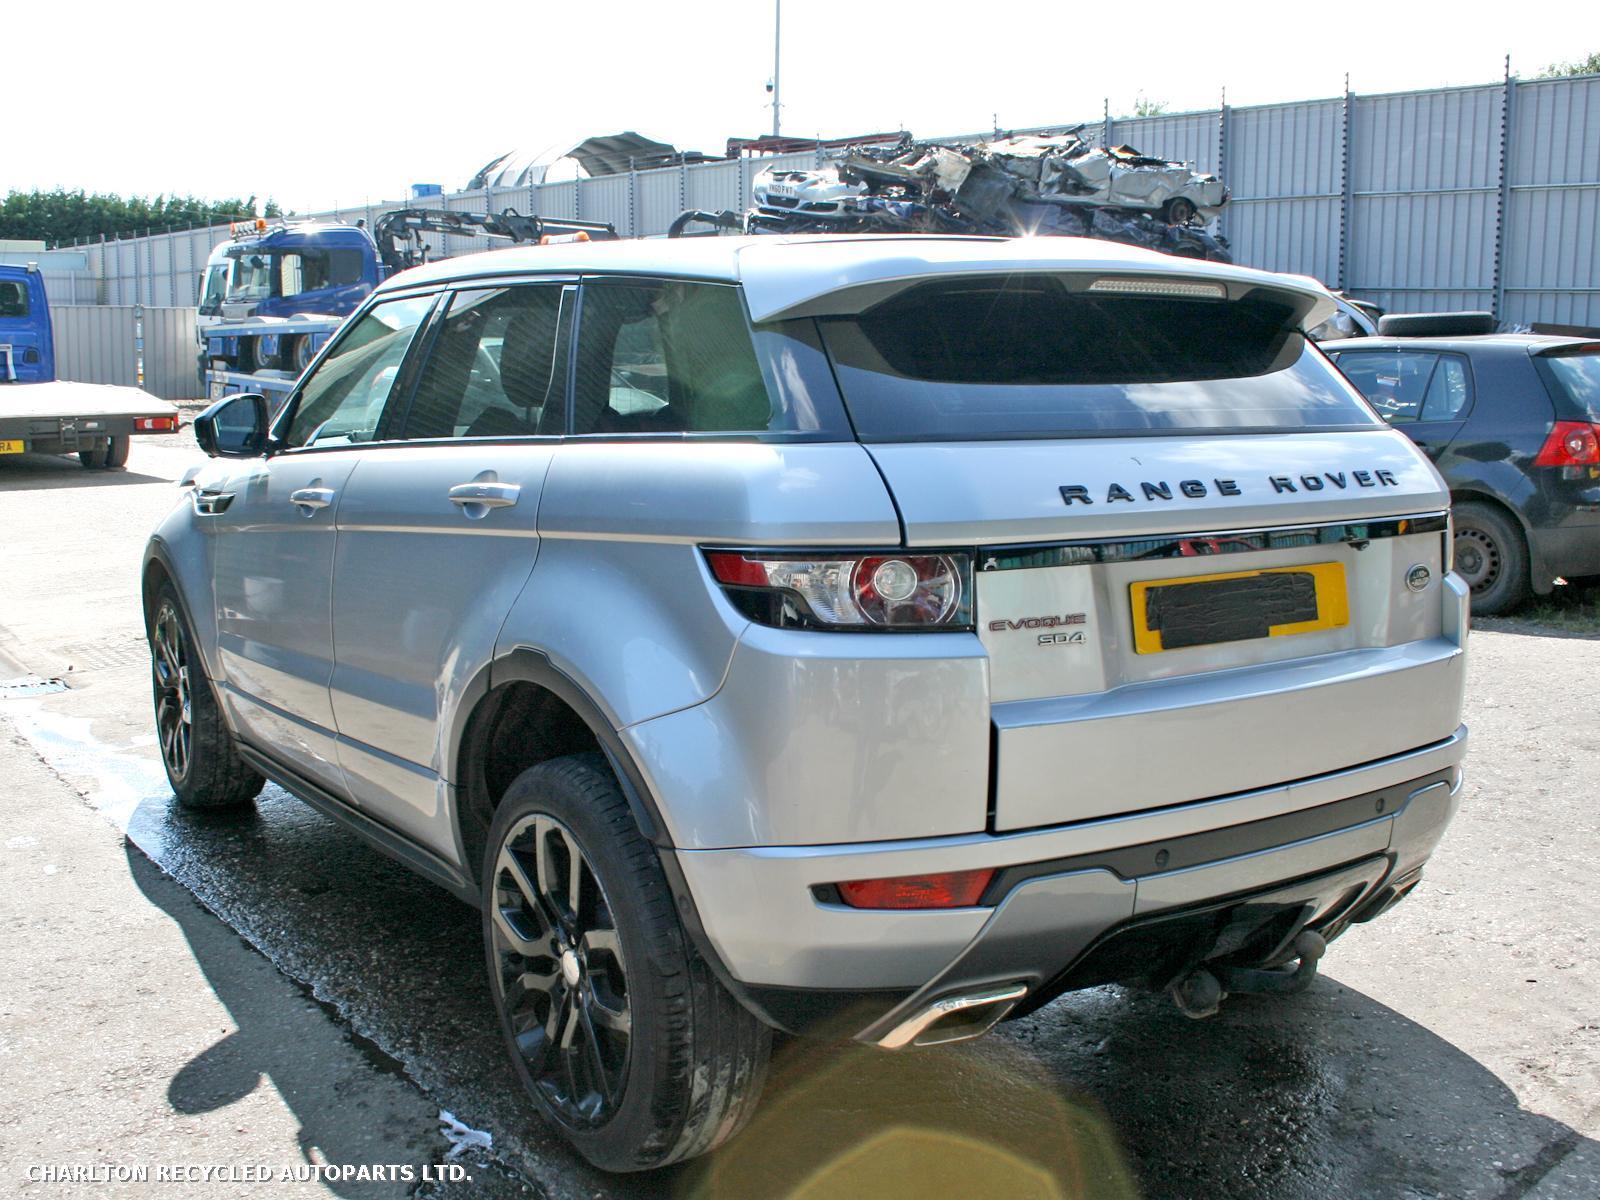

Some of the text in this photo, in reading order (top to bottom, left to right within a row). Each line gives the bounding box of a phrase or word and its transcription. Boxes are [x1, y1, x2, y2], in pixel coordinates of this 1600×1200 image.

[1059, 469, 1399, 506] RANGE ROVER
[989, 613, 1086, 632] EVOQUE
[1037, 631, 1086, 646] SD4
